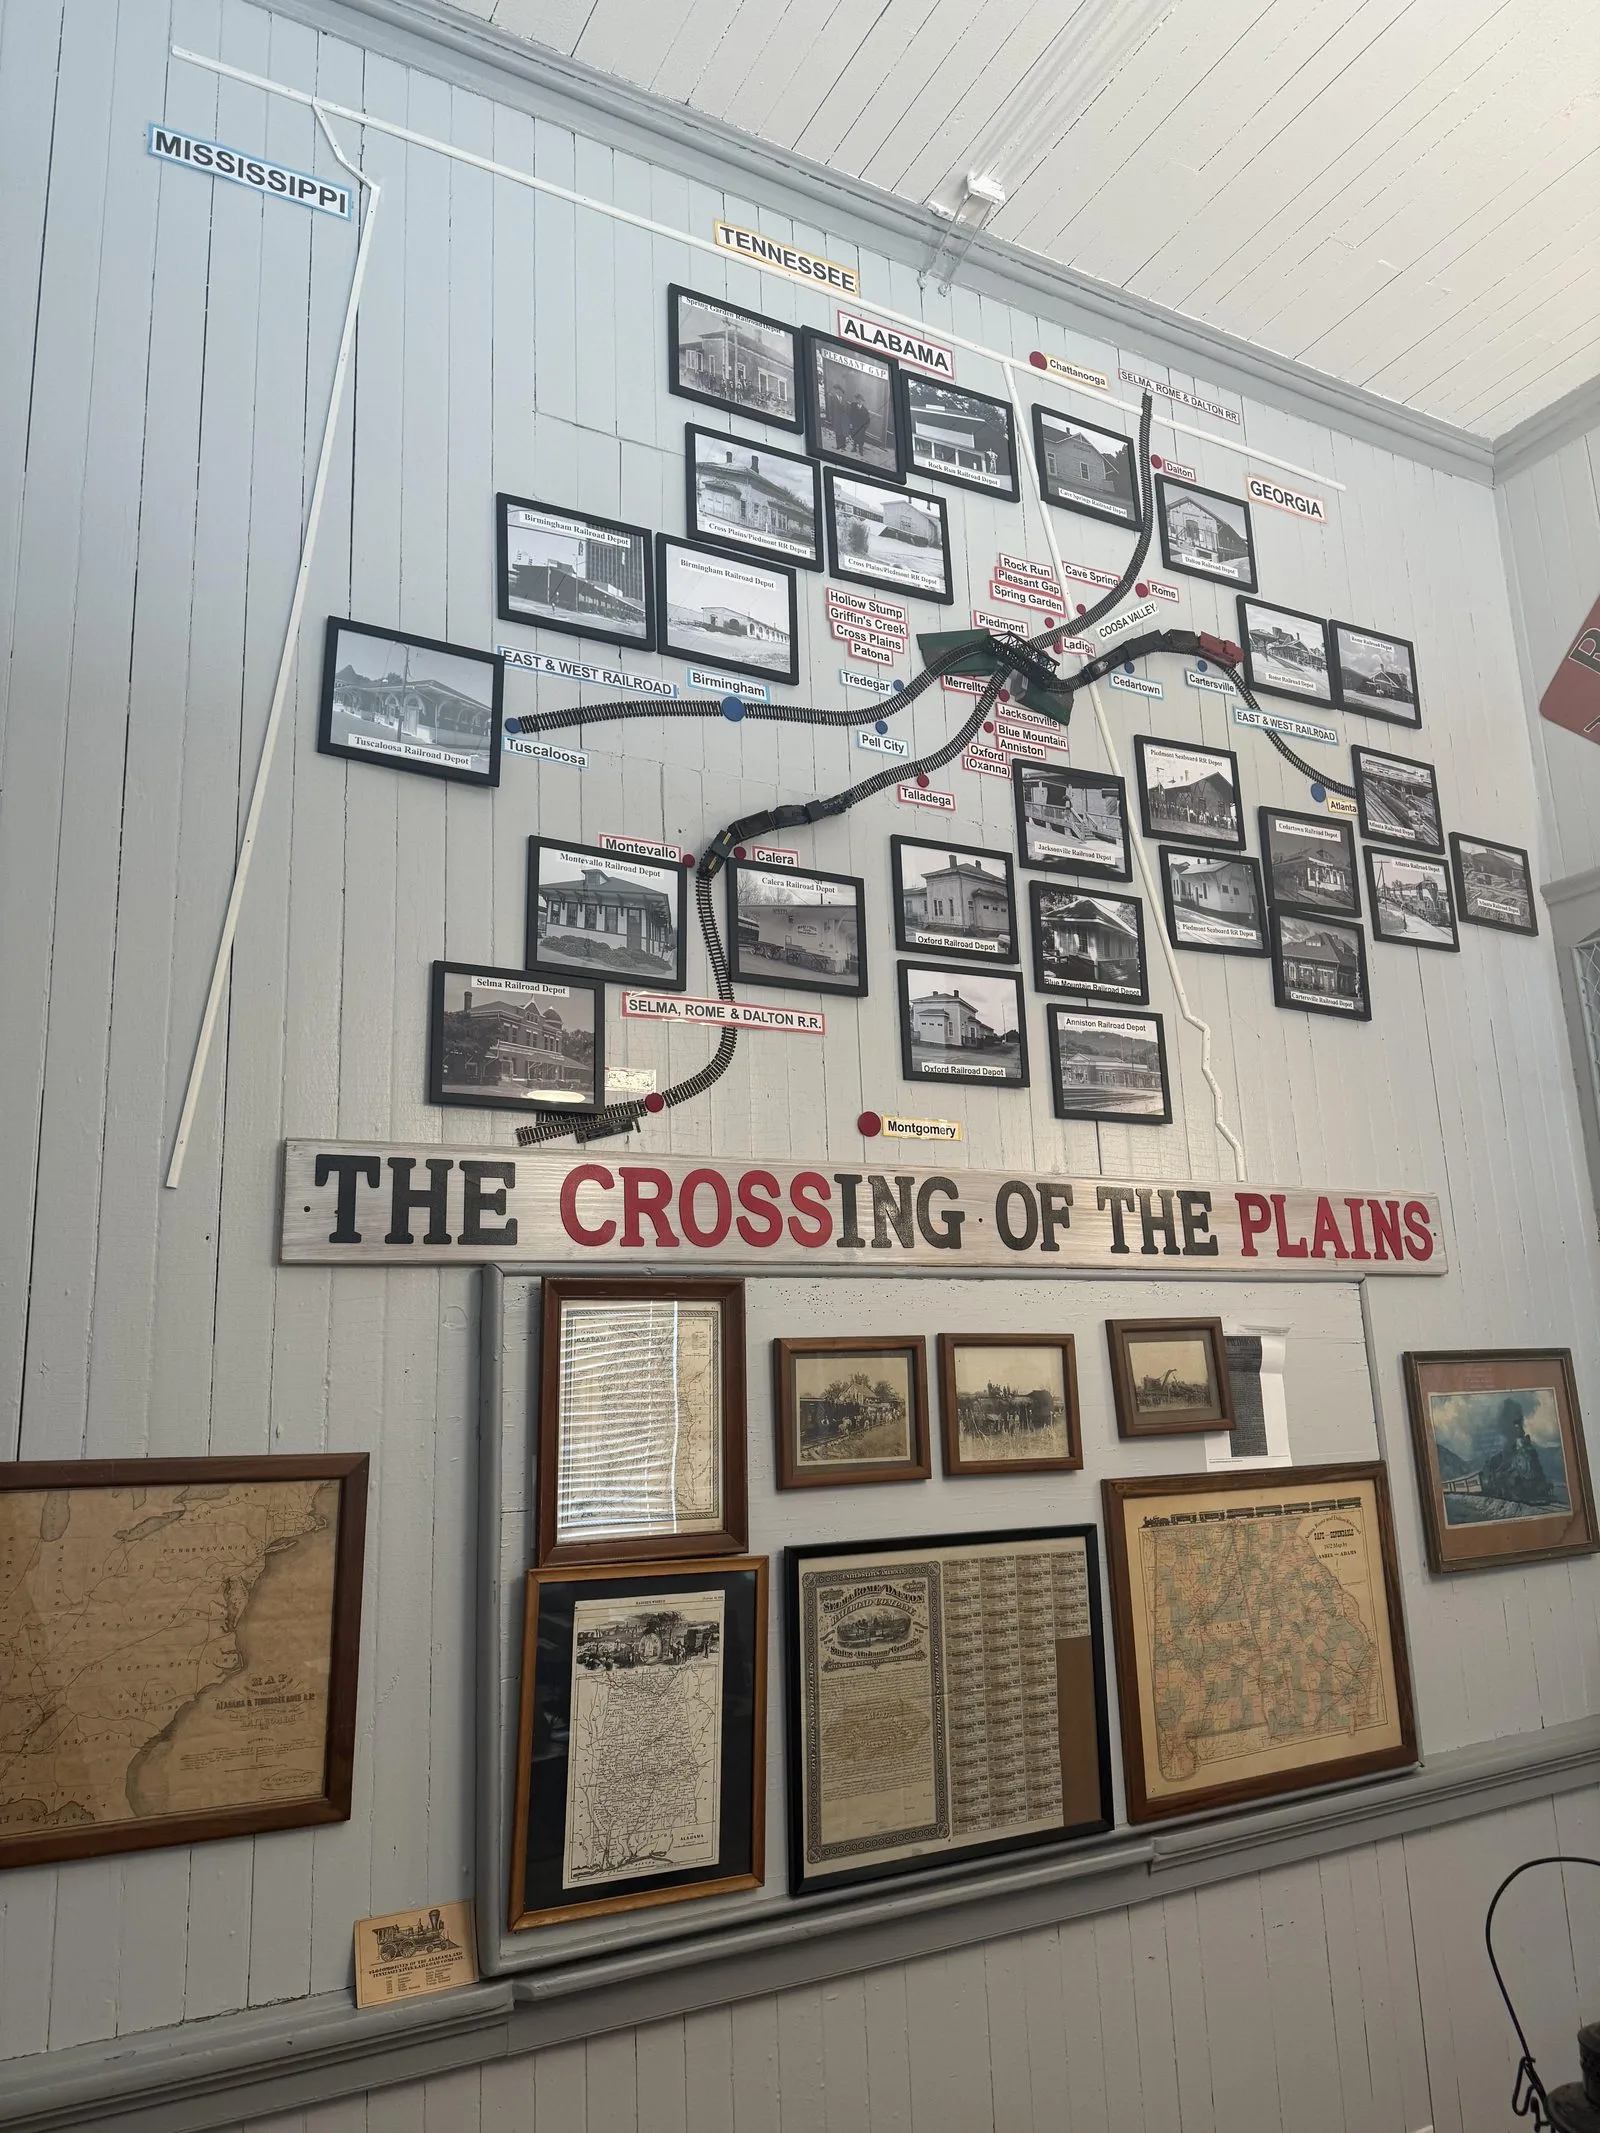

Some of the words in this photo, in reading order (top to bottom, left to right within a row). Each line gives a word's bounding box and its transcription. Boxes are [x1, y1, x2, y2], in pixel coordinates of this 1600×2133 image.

[155, 130, 346, 214] MISSISSIPPI
[719, 225, 856, 293] TENNESSEE
[844, 319, 949, 371] ALABAMA
[824, 350, 864, 371] PLEASANT
[868, 366, 886, 378] GAP
[1050, 359, 1106, 386] Chattanooga
[1156, 384, 1180, 401] ROME
[1191, 395, 1223, 416] DALTON
[1226, 410, 1237, 422] RR
[928, 461, 942, 471] Rock
[944, 465, 956, 474] Run
[957, 467, 980, 481] Railroad
[982, 475, 998, 486] Depot
[1166, 462, 1193, 478] Dalton
[1250, 480, 1322, 518] GEORGIA
[524, 513, 572, 534] Birmingham
[574, 525, 606, 541] Railroad
[606, 534, 629, 547] Depot
[708, 522, 727, 533] Cross
[728, 528, 776, 547] Plains/Piedmont
[778, 542, 788, 550] RR
[790, 544, 807, 556] Depot
[680, 559, 723, 579] Birmingham
[724, 569, 754, 585] Railroad
[754, 577, 775, 590] Depot
[848, 558, 864, 568] Cross
[921, 576, 937, 586] Depot
[1004, 558, 1028, 572] Rock
[1030, 564, 1050, 576] Run
[1066, 566, 1088, 578] Cave
[1090, 572, 1118, 587] Spring
[998, 570, 1039, 589] Pleasant
[1041, 582, 1060, 595] Gap
[1152, 585, 1176, 598] Rome
[830, 591, 866, 609] Hollow
[868, 602, 902, 619] Stump
[994, 585, 1026, 603] Spring
[1028, 594, 1062, 611] Garden
[830, 608, 872, 626] Griffin's
[875, 620, 905, 635] Creek
[979, 614, 1025, 634] Piedmont
[1100, 619, 1128, 638] COOSA
[1128, 602, 1156, 623] VALLEY
[836, 624, 866, 641] Cross
[869, 633, 901, 650] Plains
[854, 644, 890, 662] Patona
[504, 650, 542, 668] EAST
[546, 658, 556, 671] &
[559, 662, 598, 681] WEST
[602, 671, 672, 695] RAILROAD
[842, 672, 890, 692] Tredegar
[1189, 674, 1234, 692] Cartersville
[692, 672, 765, 698] Birmingham
[945, 676, 988, 692] Merrellto
[1112, 676, 1160, 695] Cedartown
[1000, 706, 1058, 728] Jacksonville
[1238, 712, 1260, 723] EAST
[1262, 716, 1269, 726] &
[1270, 718, 1294, 731] WEST
[1296, 724, 1335, 741] RAILROAD
[862, 734, 880, 748] Pell
[884, 740, 904, 754] City
[998, 724, 1020, 738] Blue
[1022, 730, 1066, 748] Mountain
[354, 736, 402, 753] Tuscaloosa
[404, 746, 442, 761] Railroad
[444, 753, 469, 767] Depot
[507, 738, 586, 766] Tuscaloosa
[970, 744, 1004, 761] Oxford
[1000, 739, 1044, 756] Anniston
[966, 757, 1010, 777] (Oxanna)
[1150, 749, 1174, 759] Piedmont
[1208, 758, 1222, 768] Depot
[902, 788, 952, 806] Talladega
[1330, 801, 1356, 813] Atlanta
[606, 838, 677, 859] Montevallo
[756, 850, 794, 865] Calera
[1038, 844, 1070, 855] Jacksonville
[1072, 849, 1095, 859] Railroad
[1096, 853, 1112, 862] Depot
[560, 852, 602, 867] Montevallo
[605, 860, 637, 874] Railroad
[639, 867, 660, 878] Depot
[762, 877, 784, 887] Calera
[786, 880, 814, 891] Railroad
[816, 884, 836, 894] Depot
[1182, 924, 1206, 933] Piedmont
[1239, 930, 1254, 938] Depot
[918, 936, 942, 946] Oxford
[944, 938, 974, 949] Railroad
[974, 942, 996, 952] Depot
[476, 978, 502, 988] Selma
[504, 980, 540, 992] Railroad
[542, 985, 566, 995] Depot
[1092, 984, 1120, 994] Railroad
[1120, 987, 1140, 996] Depot
[629, 999, 680, 1016] SELMA,
[685, 1004, 725, 1018] ROME
[730, 1008, 740, 1020] &
[743, 1010, 794, 1025] DALTON
[798, 1016, 822, 1029] R.R.
[1066, 1018, 1096, 1028] Anniston
[1098, 1020, 1125, 1030] Railroad
[1126, 1024, 1146, 1032] Depot
[924, 1064, 949, 1074] Oxford
[950, 1066, 980, 1075] Railroad
[982, 1068, 1004, 1076] Depot
[888, 1120, 956, 1138] Montgomery
[315, 1153, 518, 1245] THE
[559, 1164, 966, 1249] CROSSING
[996, 1179, 1075, 1252] OF
[1096, 1185, 1219, 1256] THE
[1234, 1192, 1434, 1261] PLAINS
